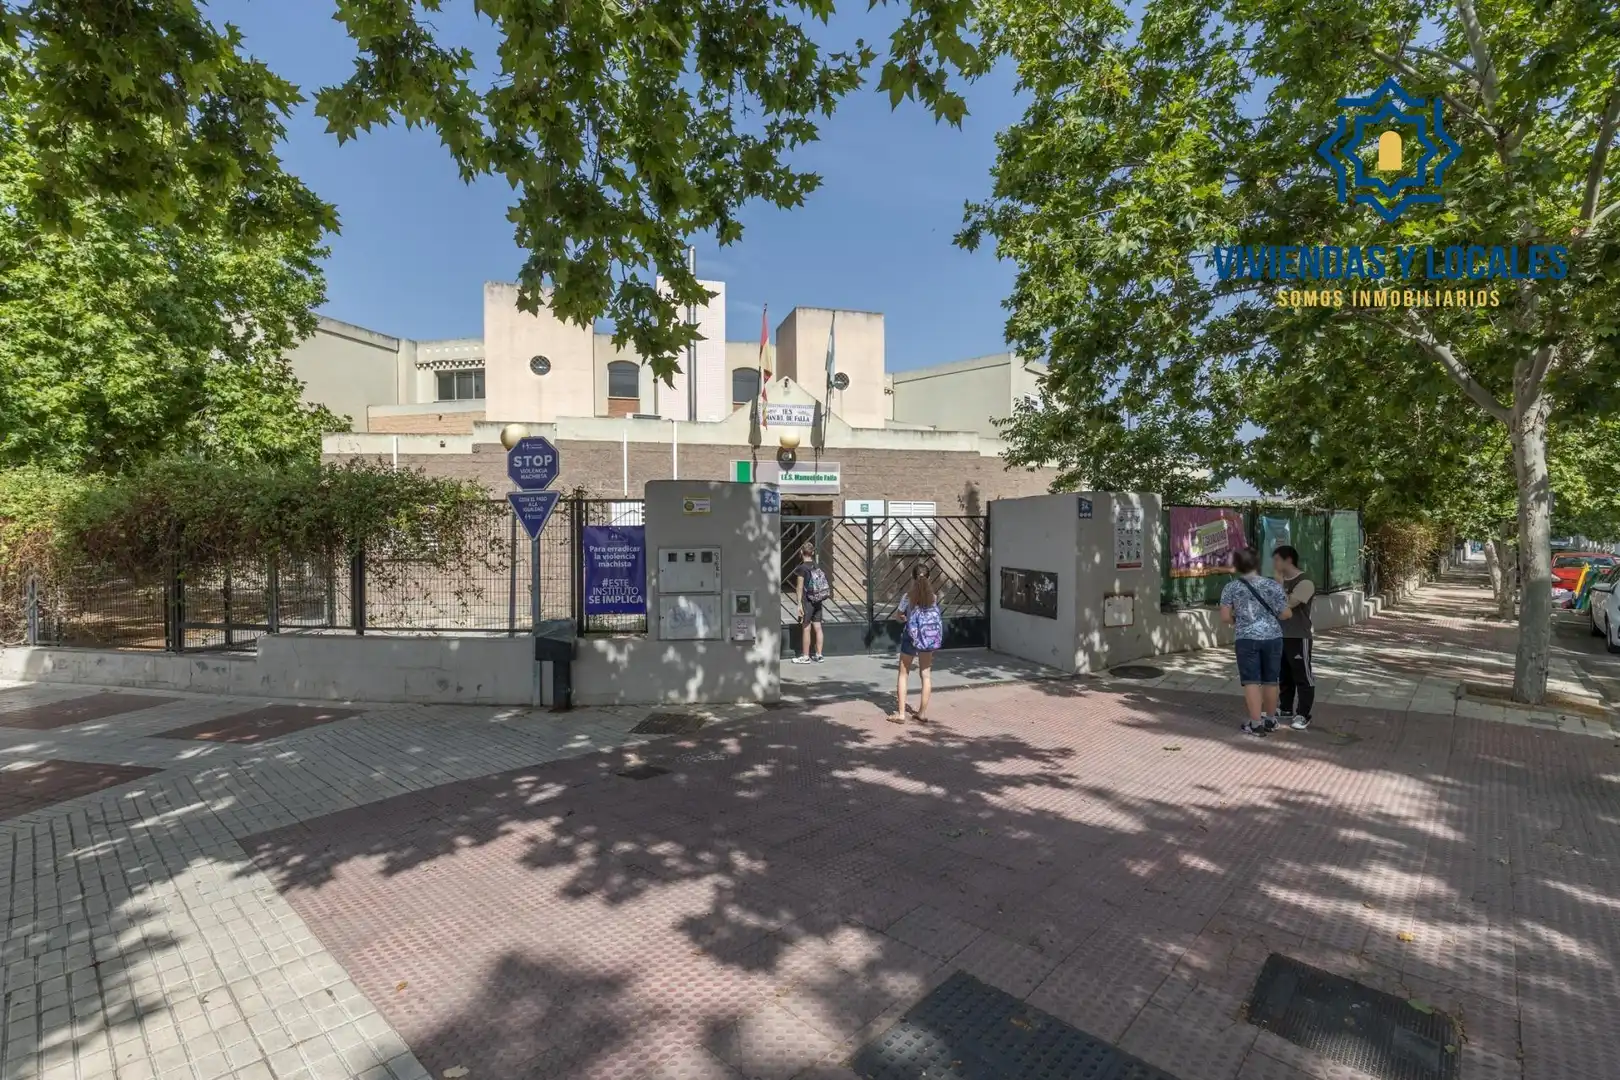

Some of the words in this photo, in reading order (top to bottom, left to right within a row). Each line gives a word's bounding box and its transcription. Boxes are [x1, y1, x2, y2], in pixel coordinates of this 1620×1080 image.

[513, 455, 553, 467] STOP
[589, 545, 606, 553] Para
[607, 545, 641, 553] erradicar
[594, 552, 601, 560] la
[602, 552, 636, 560] violencia
[598, 560, 632, 568] machista
[601, 578, 629, 588] #ESTE
[592, 586, 639, 596] INSTITUTO
[588, 595, 600, 604] SE
[602, 594, 643, 604] IMPLICA
